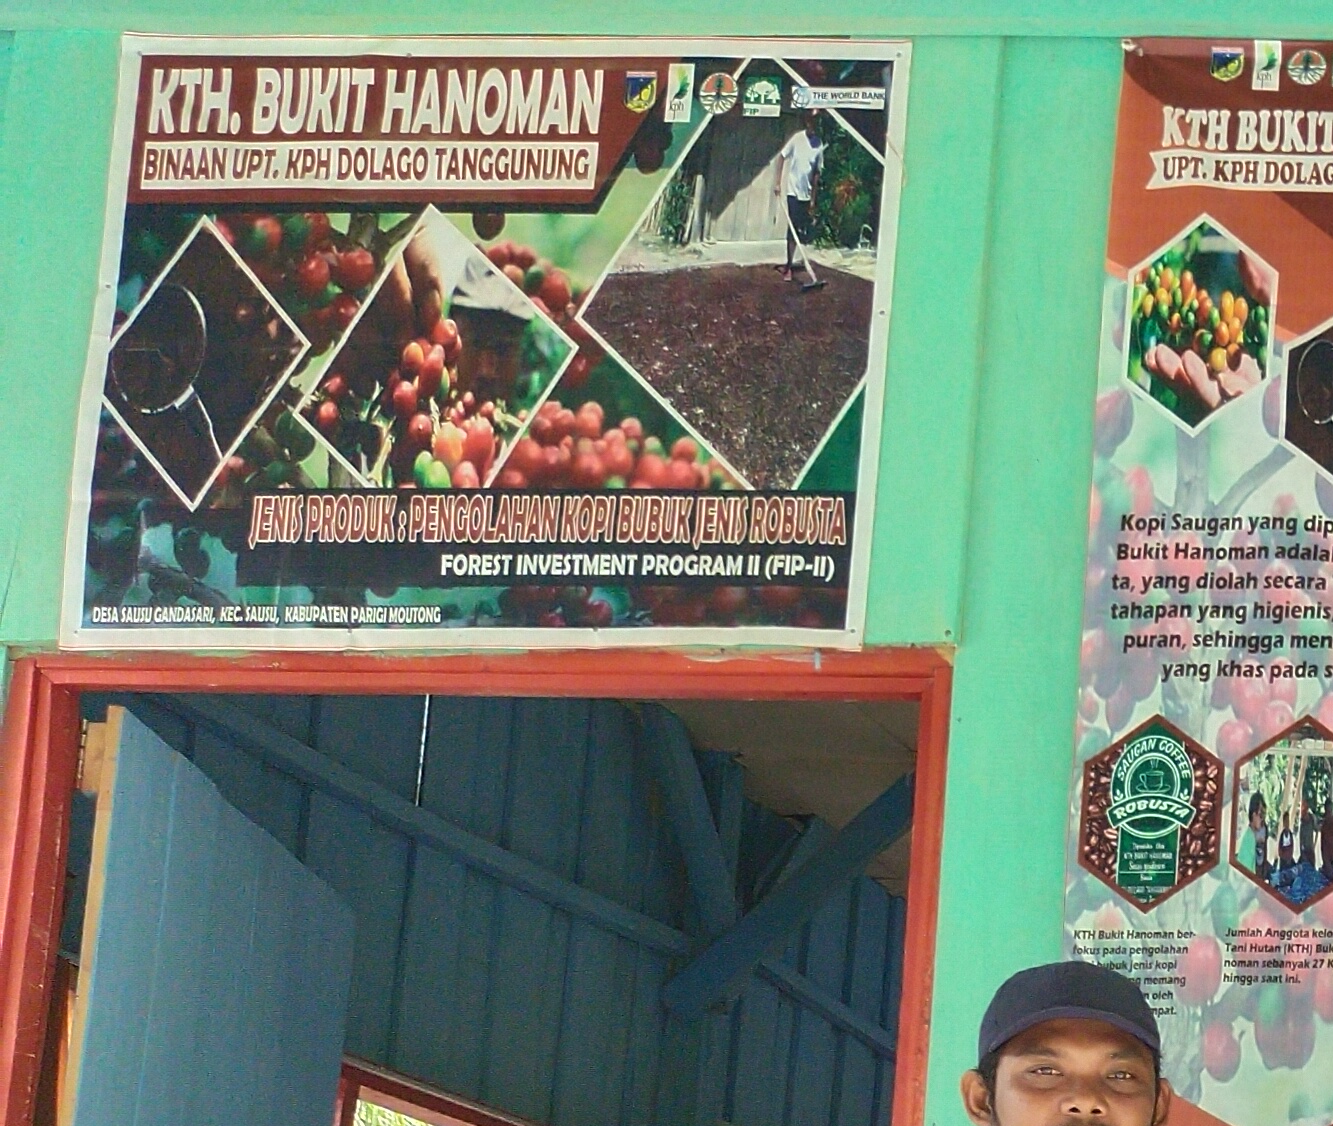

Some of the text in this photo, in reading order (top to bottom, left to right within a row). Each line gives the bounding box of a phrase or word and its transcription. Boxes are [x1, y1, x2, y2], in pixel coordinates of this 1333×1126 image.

[148, 67, 604, 135] KTH. BUKIT HANOMAN
[1162, 106, 1230, 150] KTH
[143, 146, 590, 182] BINAAN UPT. KPH DOLAGO TANGGUNUNG
[1163, 156, 1208, 180] UPT.
[1213, 160, 1258, 184] KPH
[249, 495, 846, 550] JENIS PRODUK PENGOLAHAN KOPI BUBUK JENIS ROBUSTA
[1120, 513, 1166, 535] Kopi
[1171, 513, 1243, 536] Saugan
[1247, 515, 1297, 536] yang
[1117, 543, 1168, 560] Bukit
[1174, 543, 1269, 561] Hanoman
[441, 554, 835, 582] FOREST INVESTMENT PROGRAM II (FIP-II)
[1111, 573, 1136, 592] ta,
[1140, 575, 1190, 594] yang
[1196, 572, 1258, 590] diolah
[1263, 575, 1326, 591] secara
[92, 606, 441, 624] DESA SAUSU GANDASARI, KEC. SAUSU, KABUPATEN PARIGI MOUTONG
[1110, 602, 1192, 624] tahapan
[1196, 605, 1247, 624] yang
[1123, 632, 1186, 653] puran,
[1192, 631, 1284, 654] sehingga
[1161, 662, 1210, 682] yang
[1216, 659, 1264, 678] khas
[1269, 660, 1318, 683] pada
[1113, 799, 1190, 819] ROBUSTA
[1073, 930, 1174, 940] KTH Bukit Hanoman
[1225, 928, 1262, 938] Jumlah
[1265, 928, 1309, 940] Anggota
[1072, 945, 1189, 957] fokus pada pengolahan
[1225, 943, 1247, 953] Tani
[1250, 944, 1280, 953] Hutan
[1283, 944, 1313, 956] (KTH)
[1224, 959, 1259, 968] noman
[1262, 959, 1310, 971] sebanyak
[1312, 959, 1325, 968] 27
